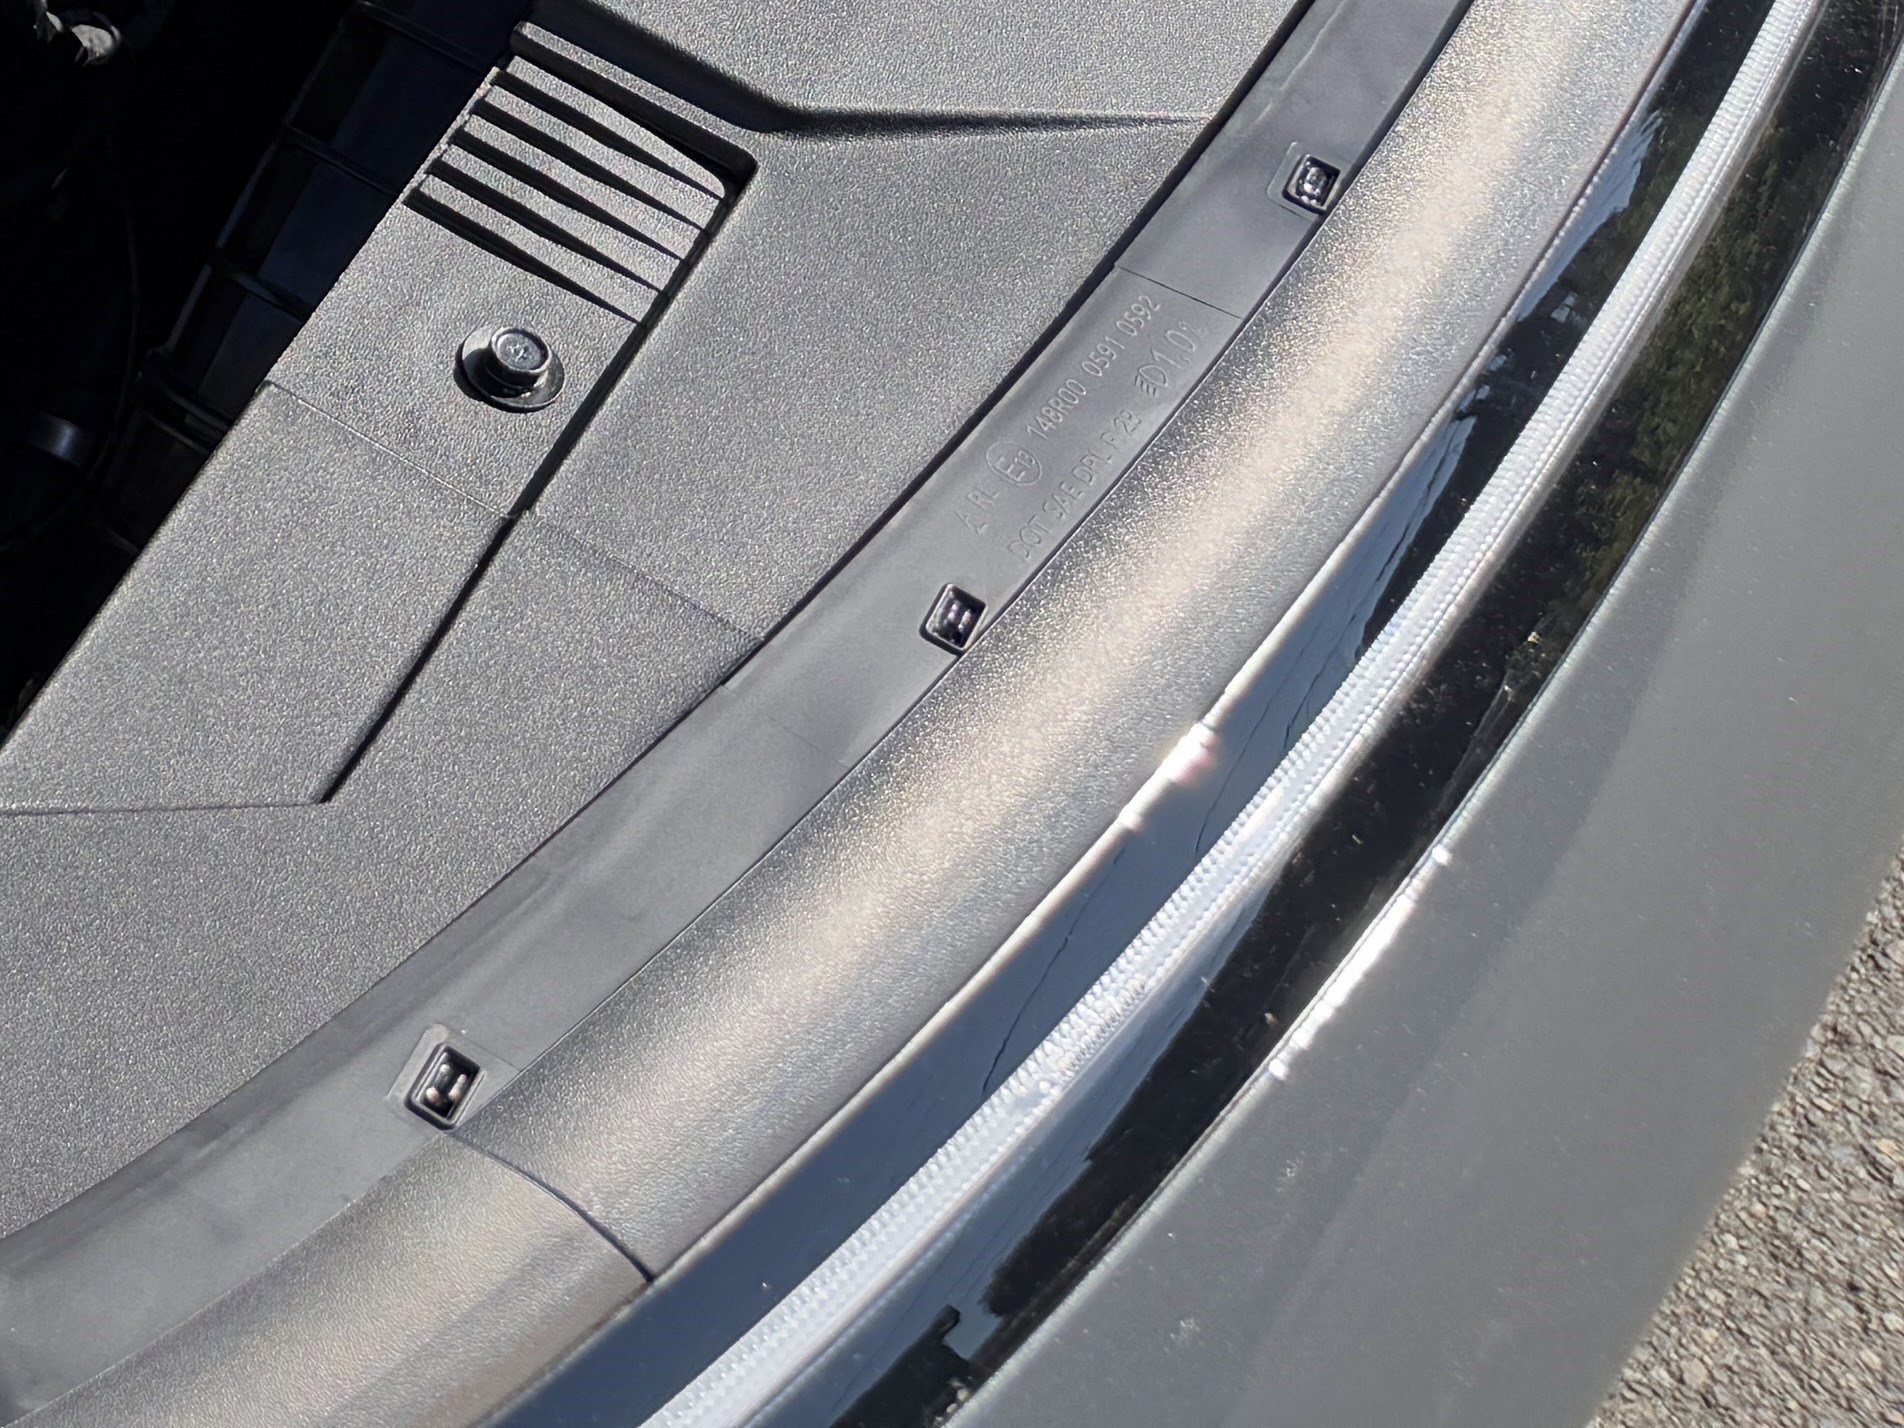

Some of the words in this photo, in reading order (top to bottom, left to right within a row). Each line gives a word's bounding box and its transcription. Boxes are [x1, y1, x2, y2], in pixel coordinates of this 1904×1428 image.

[1027, 379, 1087, 441] 148R00
[1082, 337, 1125, 377] 0591
[1116, 295, 1162, 336] 0592
